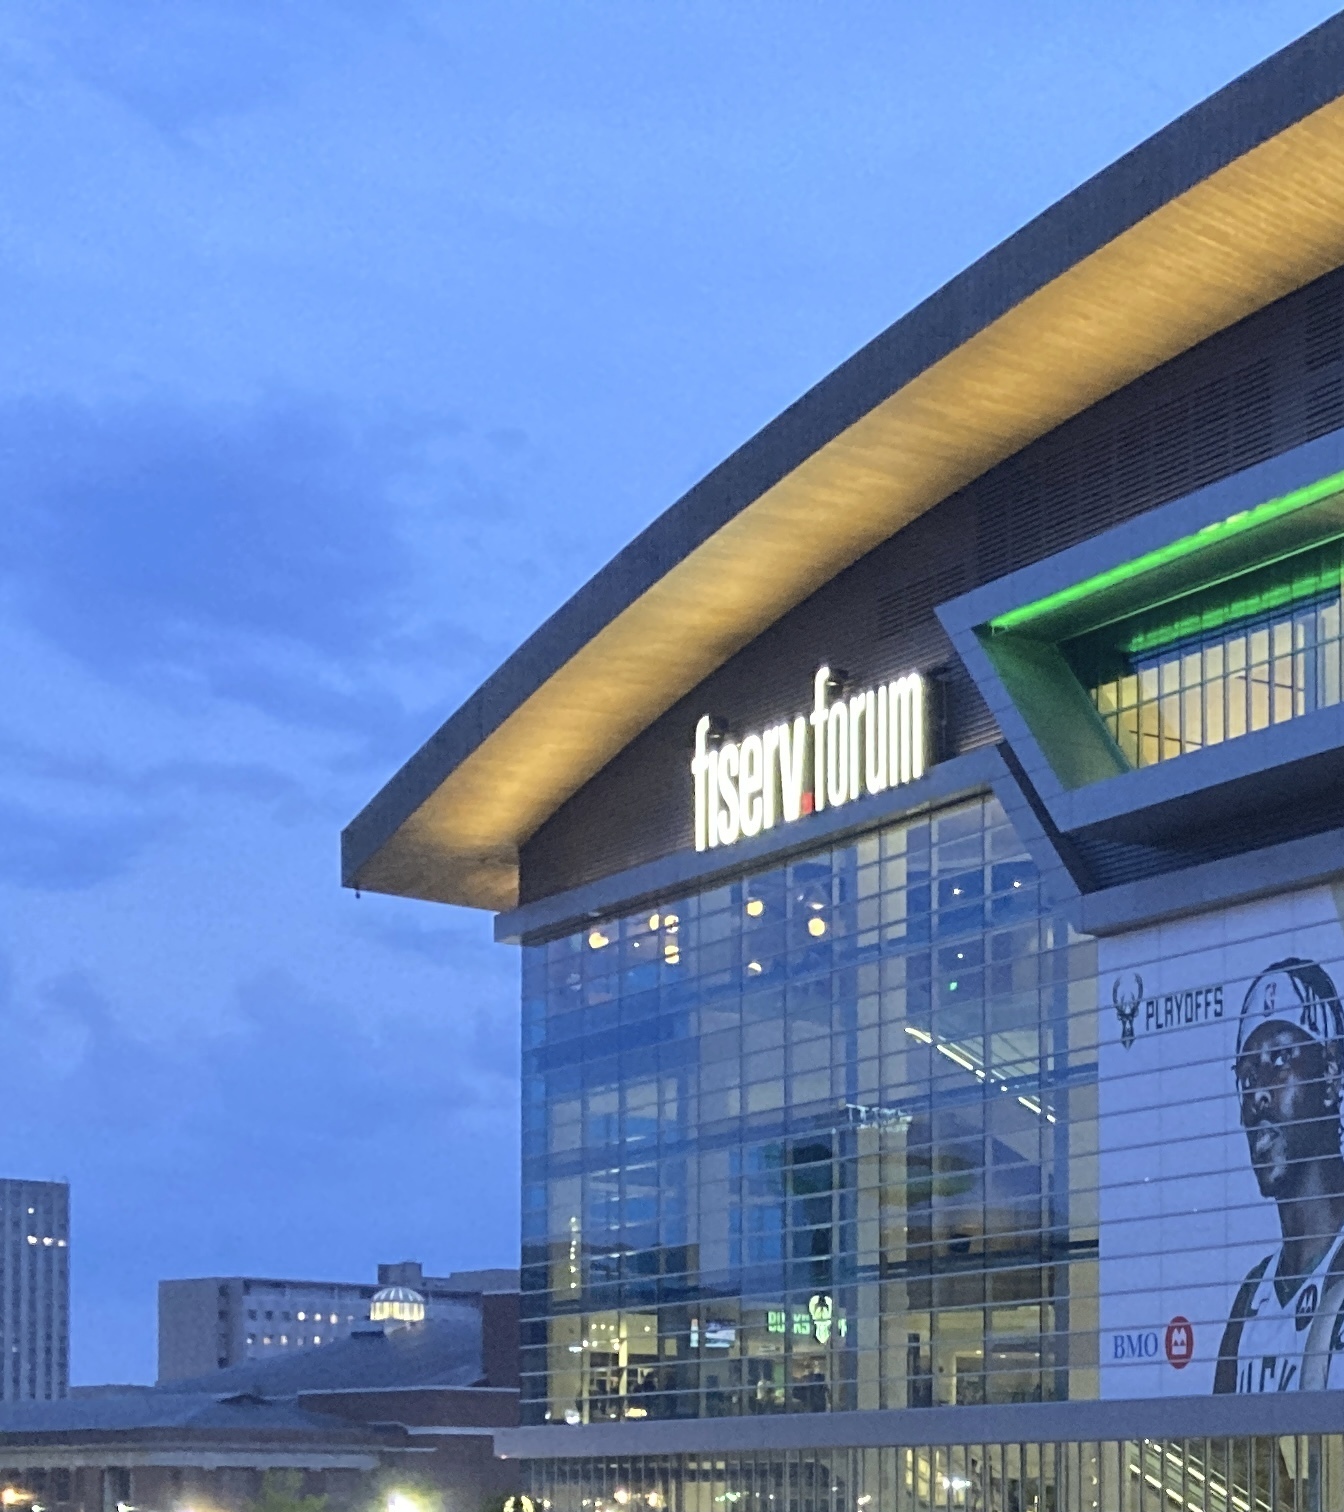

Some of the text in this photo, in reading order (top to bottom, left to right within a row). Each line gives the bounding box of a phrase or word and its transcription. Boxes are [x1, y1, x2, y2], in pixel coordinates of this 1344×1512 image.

[810, 666, 923, 812] forum
[1145, 986, 1223, 1031] PLAYOFFS
[1114, 1332, 1158, 1359] BMO
